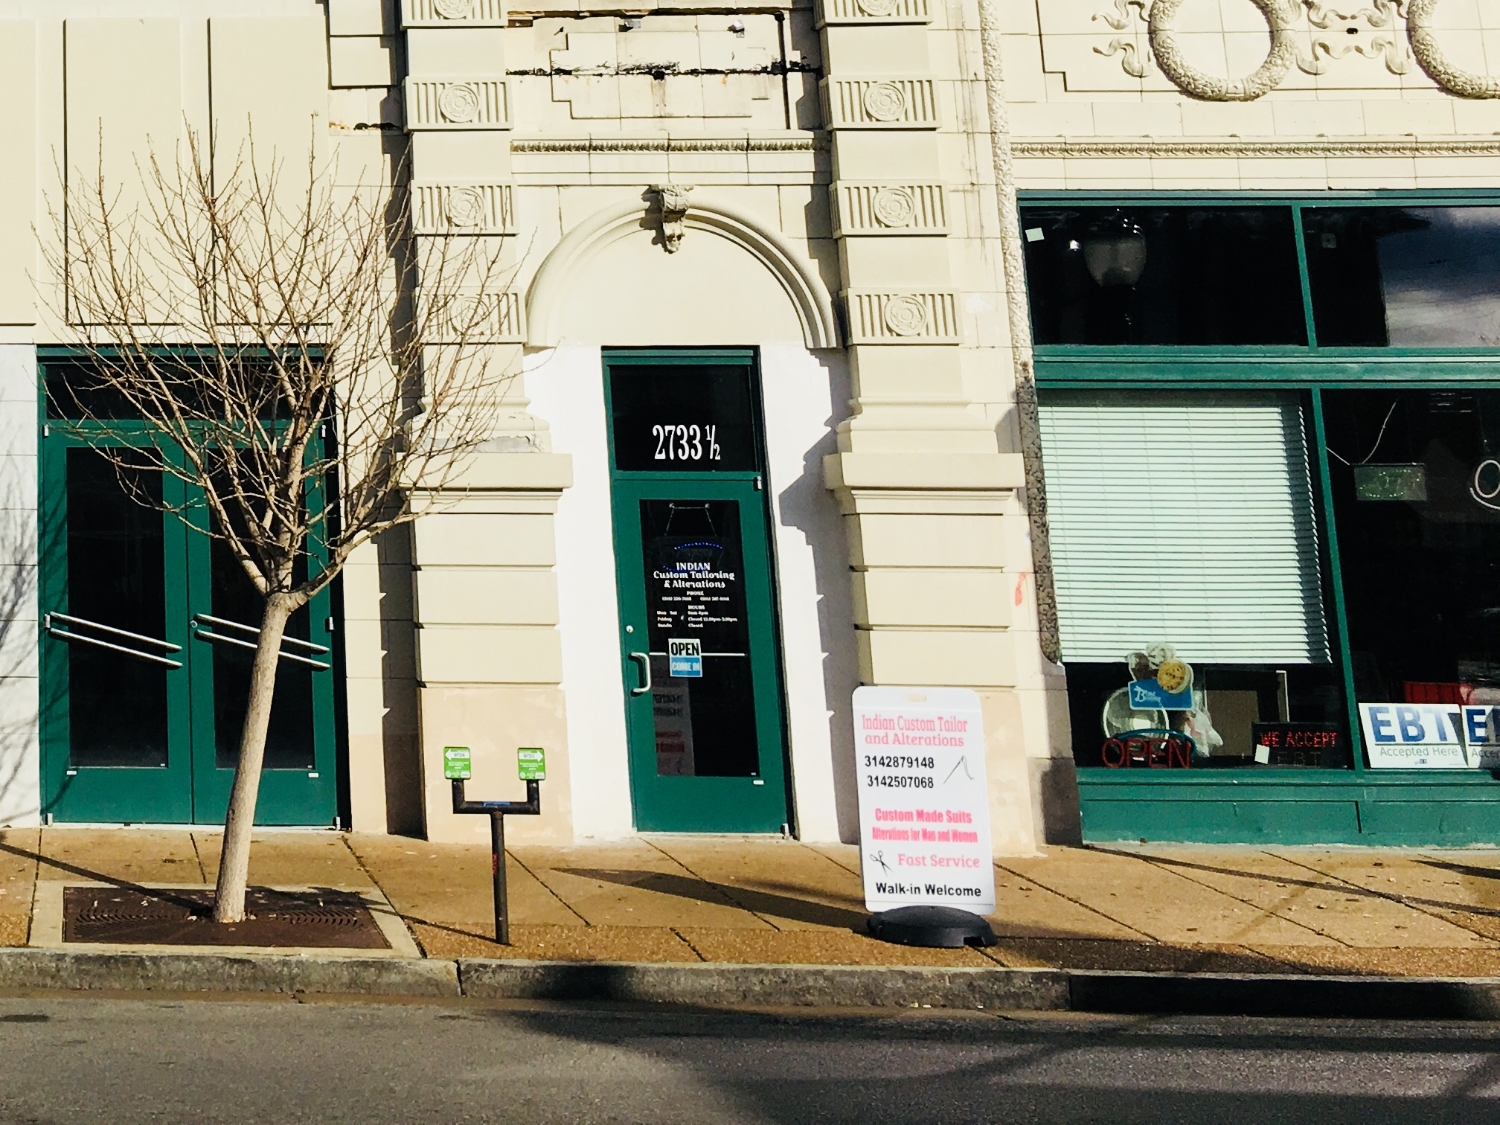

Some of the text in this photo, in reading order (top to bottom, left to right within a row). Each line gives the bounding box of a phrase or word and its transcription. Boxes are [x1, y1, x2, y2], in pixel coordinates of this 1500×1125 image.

[652, 424, 703, 460] 2733
[676, 562, 711, 571] INDIAN
[653, 571, 736, 581] Custom Tailoring
[672, 579, 726, 588] Alterations
[670, 642, 700, 656] OPEN
[672, 662, 692, 671] COME
[862, 714, 968, 732] Indian Custom Tailor
[1368, 706, 1452, 742] EBT
[865, 732, 964, 746] and Alterations
[1260, 731, 1338, 748] WE ACCEPT
[1102, 738, 1191, 768] OPEN
[1380, 747, 1458, 757] Accepted Here
[864, 755, 934, 768] 3142879148
[867, 775, 934, 788] 3142507068
[875, 808, 973, 824] Custom Made Suits
[872, 827, 909, 841] Alterations
[911, 828, 920, 841] for
[937, 829, 950, 842] and
[951, 829, 978, 843] Women
[897, 853, 980, 868] Fast Service
[875, 882, 982, 897] Walk-in Welcome
